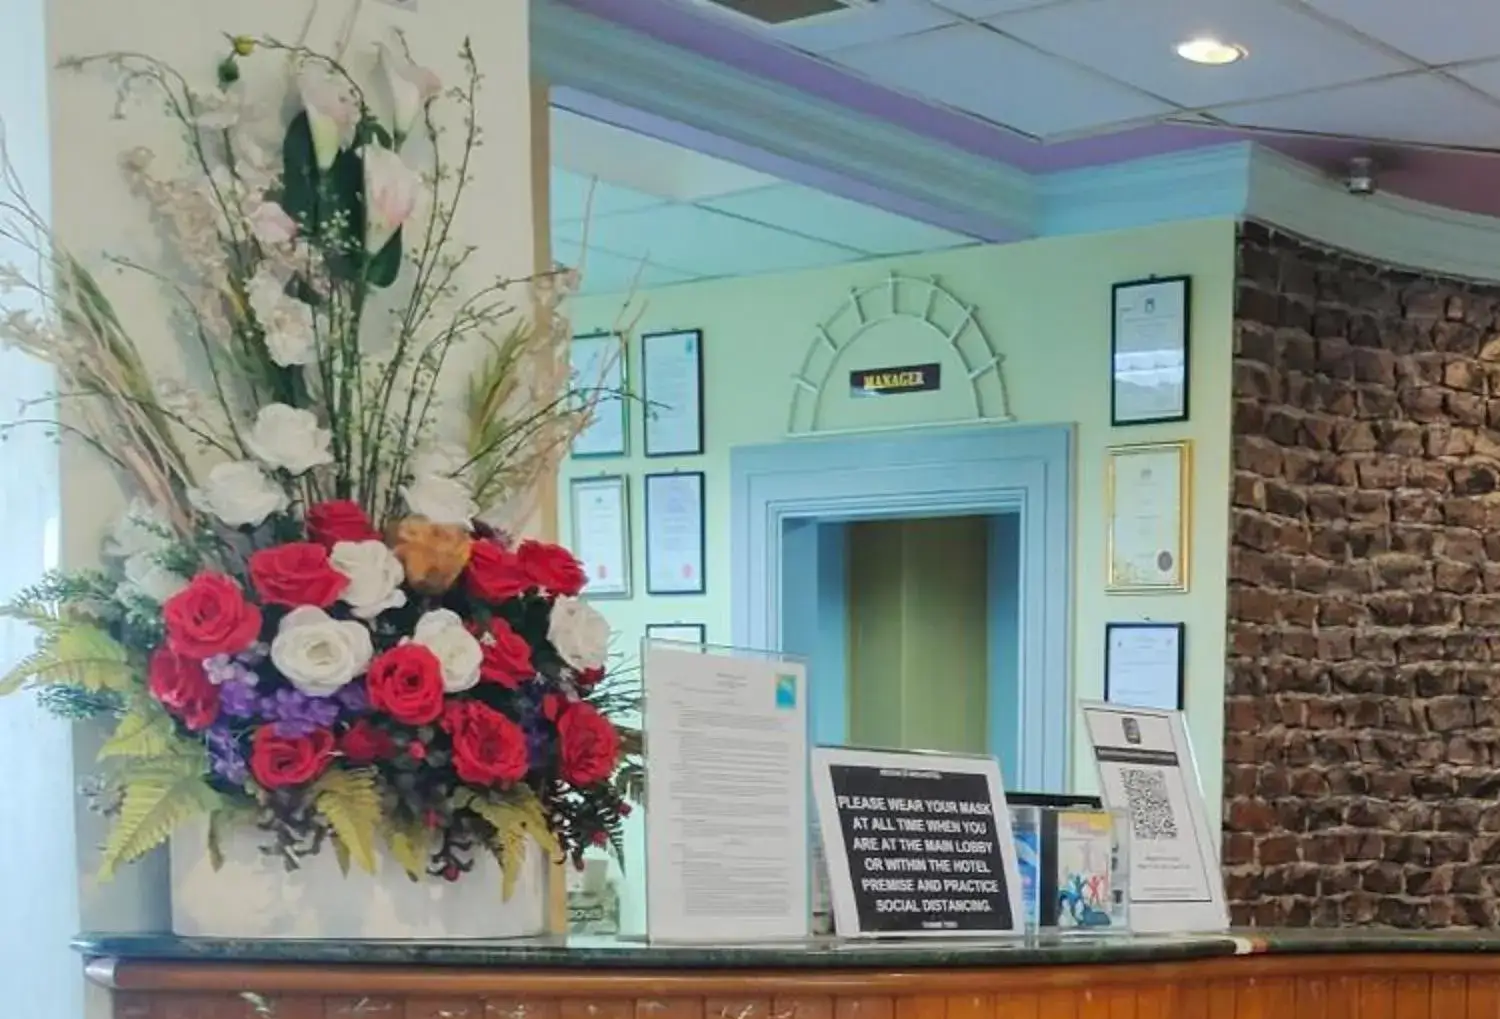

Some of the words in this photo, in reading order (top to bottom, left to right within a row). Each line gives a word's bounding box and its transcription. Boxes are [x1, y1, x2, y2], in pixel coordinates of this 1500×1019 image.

[863, 371, 925, 390] MANAGER
[837, 795, 886, 811] PLEASE
[887, 797, 924, 812] WEAR
[927, 800, 958, 814] YOUR
[960, 801, 993, 815] MASK
[853, 817, 869, 830] AT
[872, 818, 896, 831] ALL
[897, 819, 925, 832] TIME
[927, 820, 961, 833] WHEN
[962, 821, 986, 834] YOU
[853, 837, 880, 851] ARE
[881, 838, 897, 851] AT
[898, 839, 923, 851] THE
[924, 840, 954, 853] MAIN
[956, 841, 993, 854] LOBBY
[864, 857, 884, 871] OR
[884, 858, 927, 871] WITHIN
[928, 859, 952, 872] THE
[953, 860, 991, 873] HOTEL
[861, 878, 915, 892] PREMISE
[917, 879, 942, 892] AND
[943, 879, 999, 893] PRACTICE
[876, 899, 921, 912] SOCIAL
